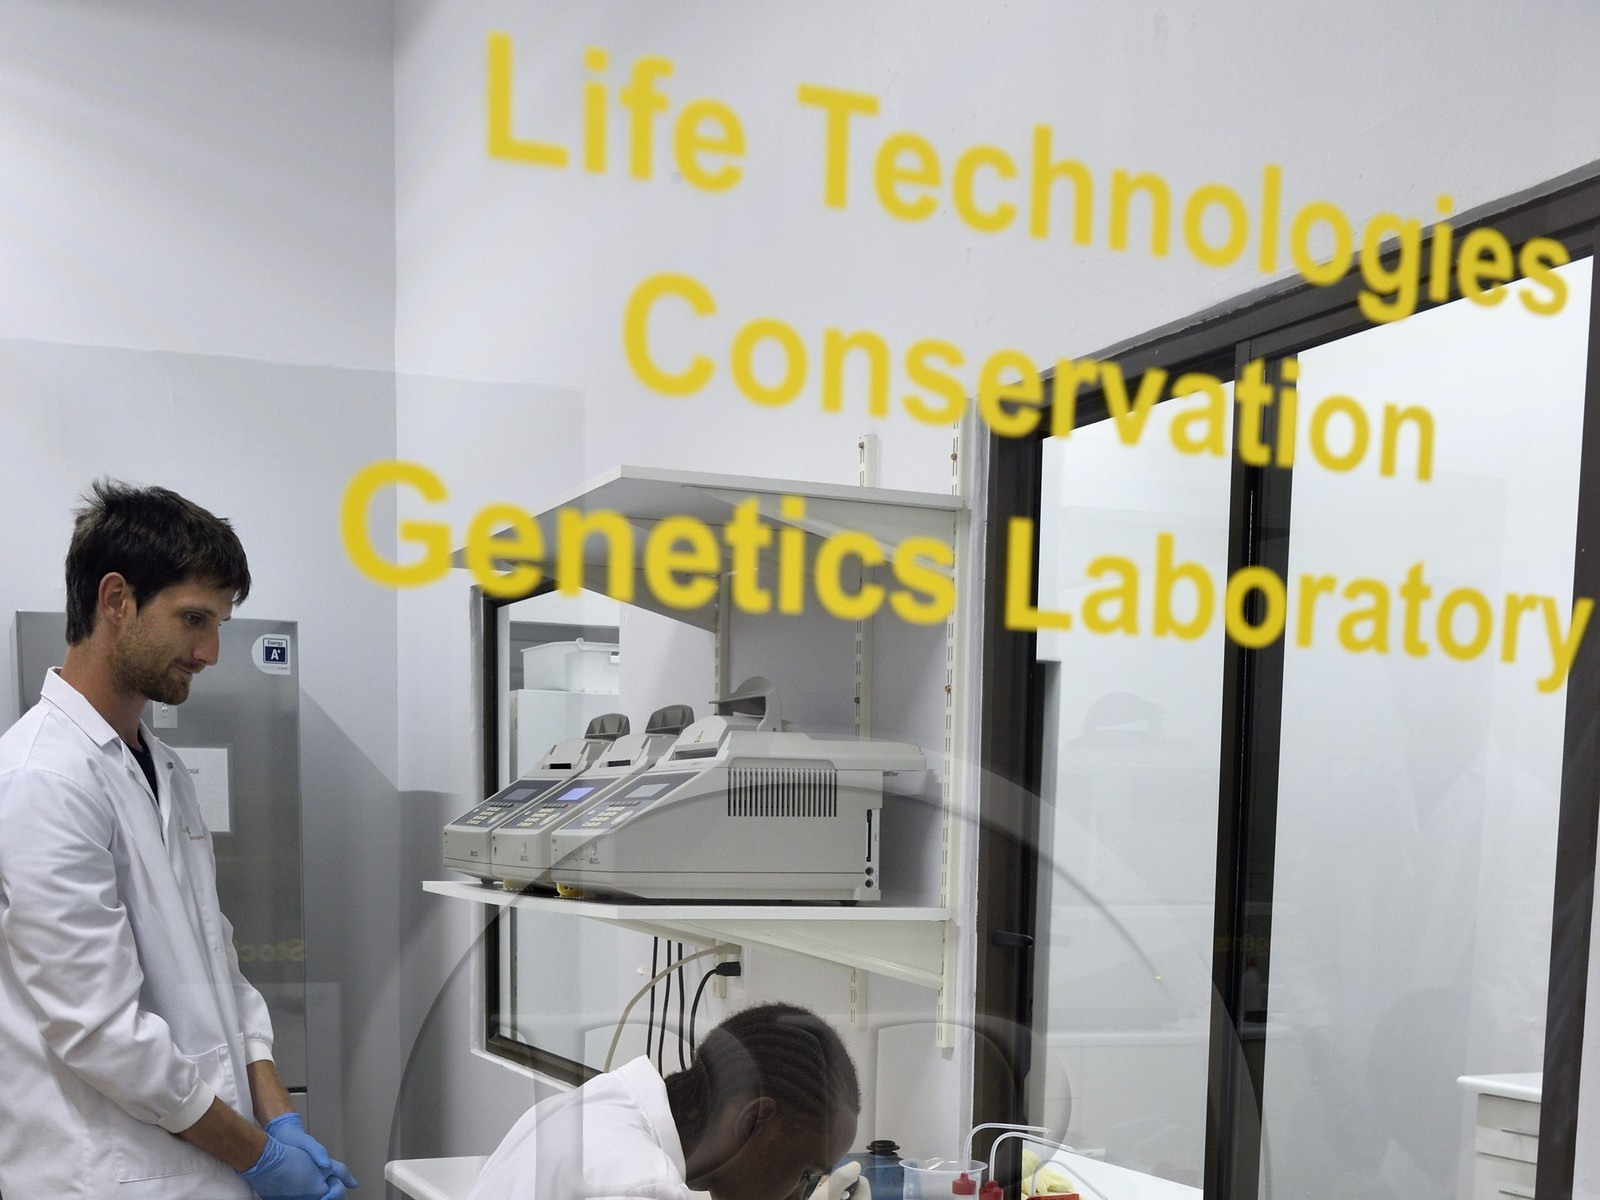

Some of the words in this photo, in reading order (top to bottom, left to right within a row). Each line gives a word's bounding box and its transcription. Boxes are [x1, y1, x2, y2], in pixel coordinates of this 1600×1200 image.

[487, 32, 747, 193] Life
[797, 84, 1572, 324] Technologies
[623, 273, 1435, 482] Conservation
[340, 459, 957, 626] Genetics
[1003, 516, 1596, 694] Laboratory
